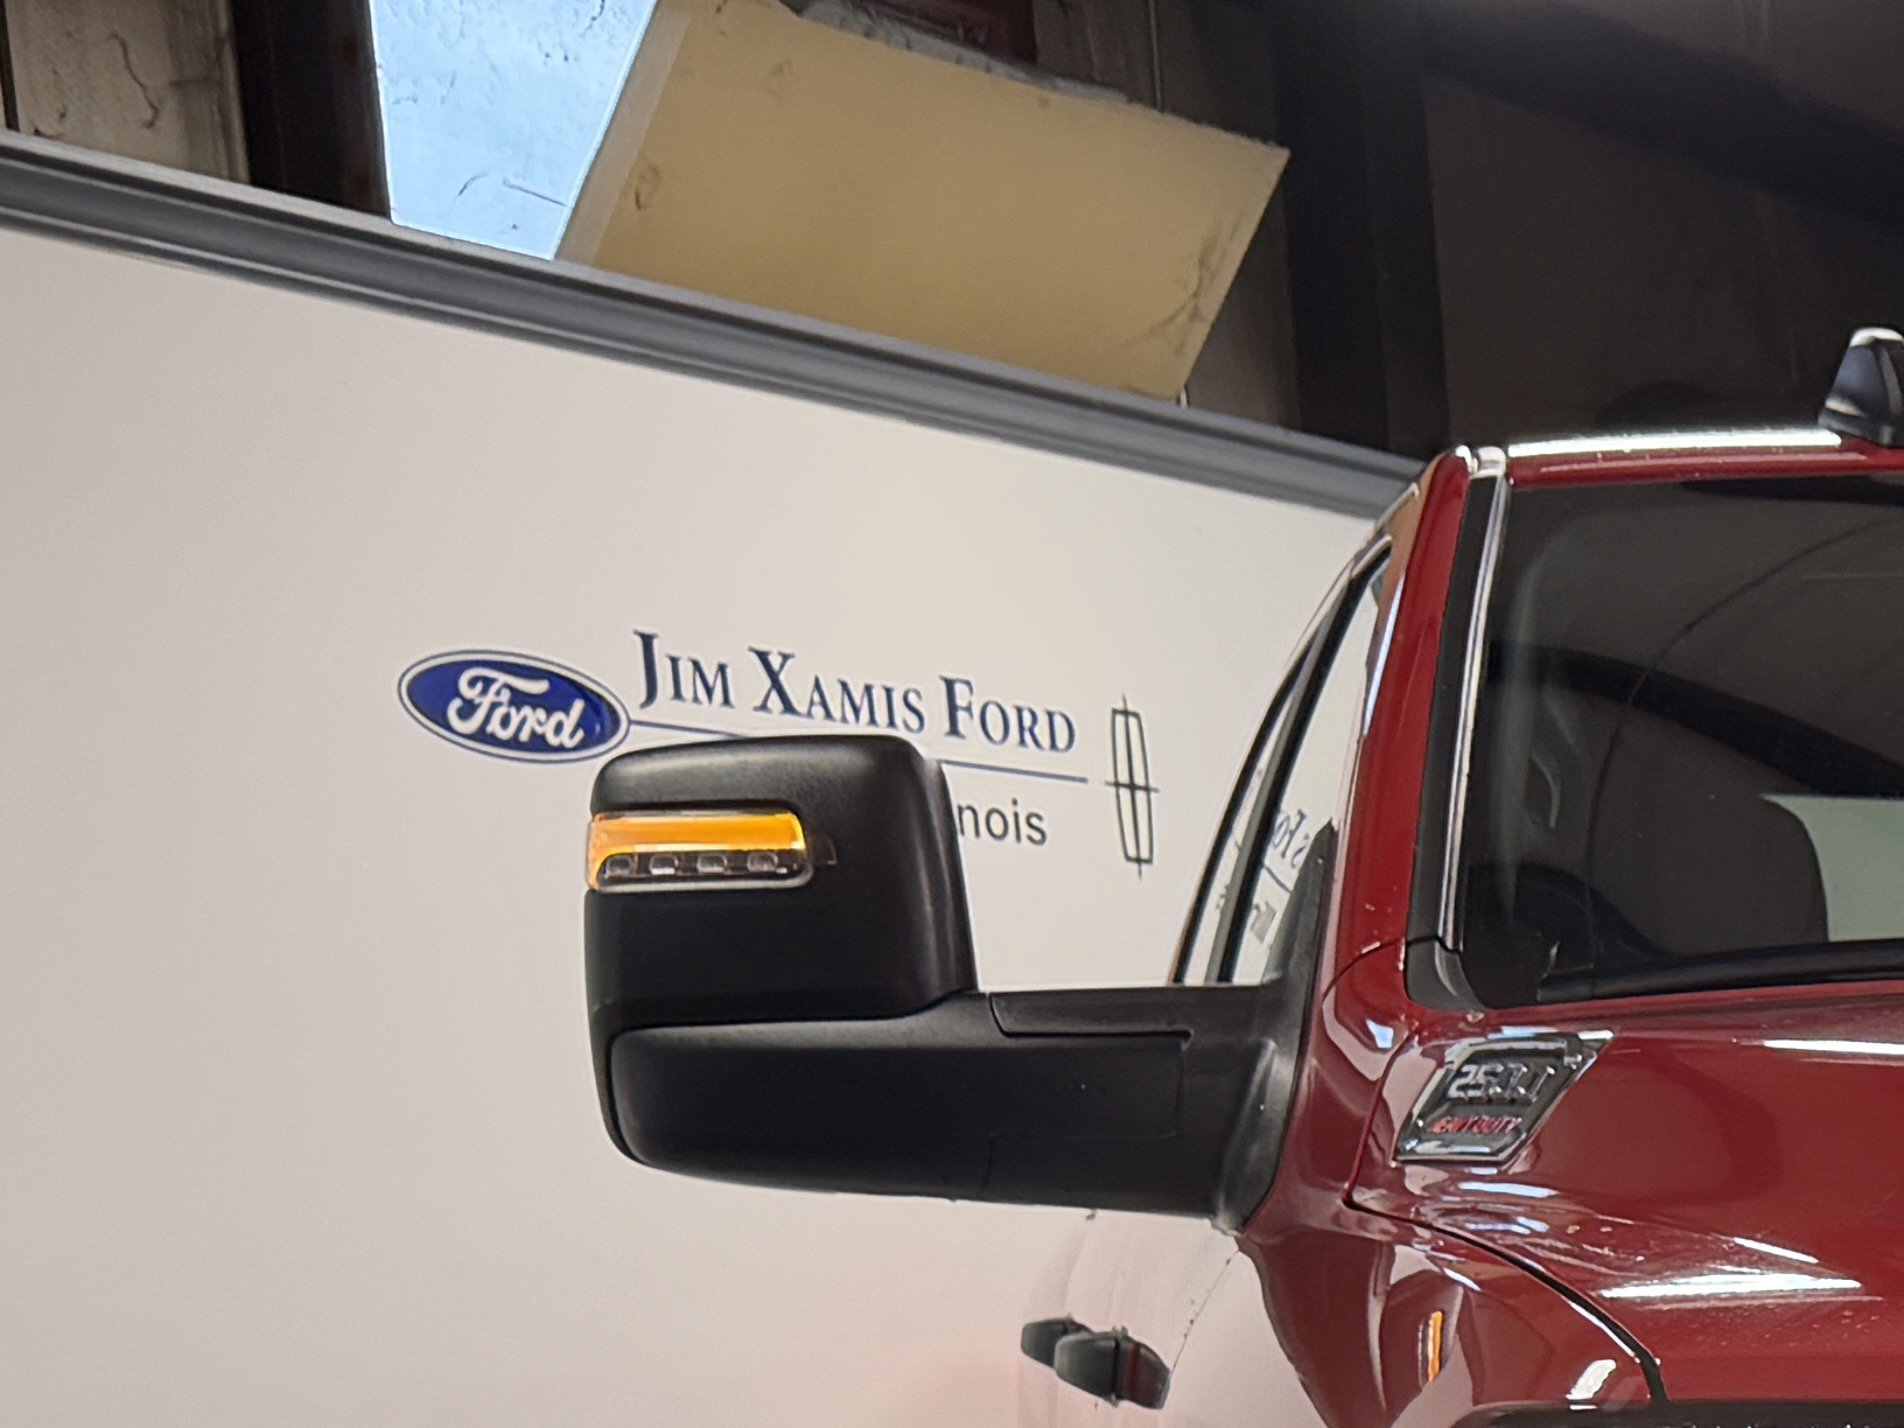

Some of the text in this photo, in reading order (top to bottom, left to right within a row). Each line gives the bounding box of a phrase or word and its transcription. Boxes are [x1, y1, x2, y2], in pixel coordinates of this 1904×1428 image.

[446, 666, 586, 751] Ford
[632, 629, 1077, 755] JIM XAMIS FORD
[956, 797, 1047, 846] nois
